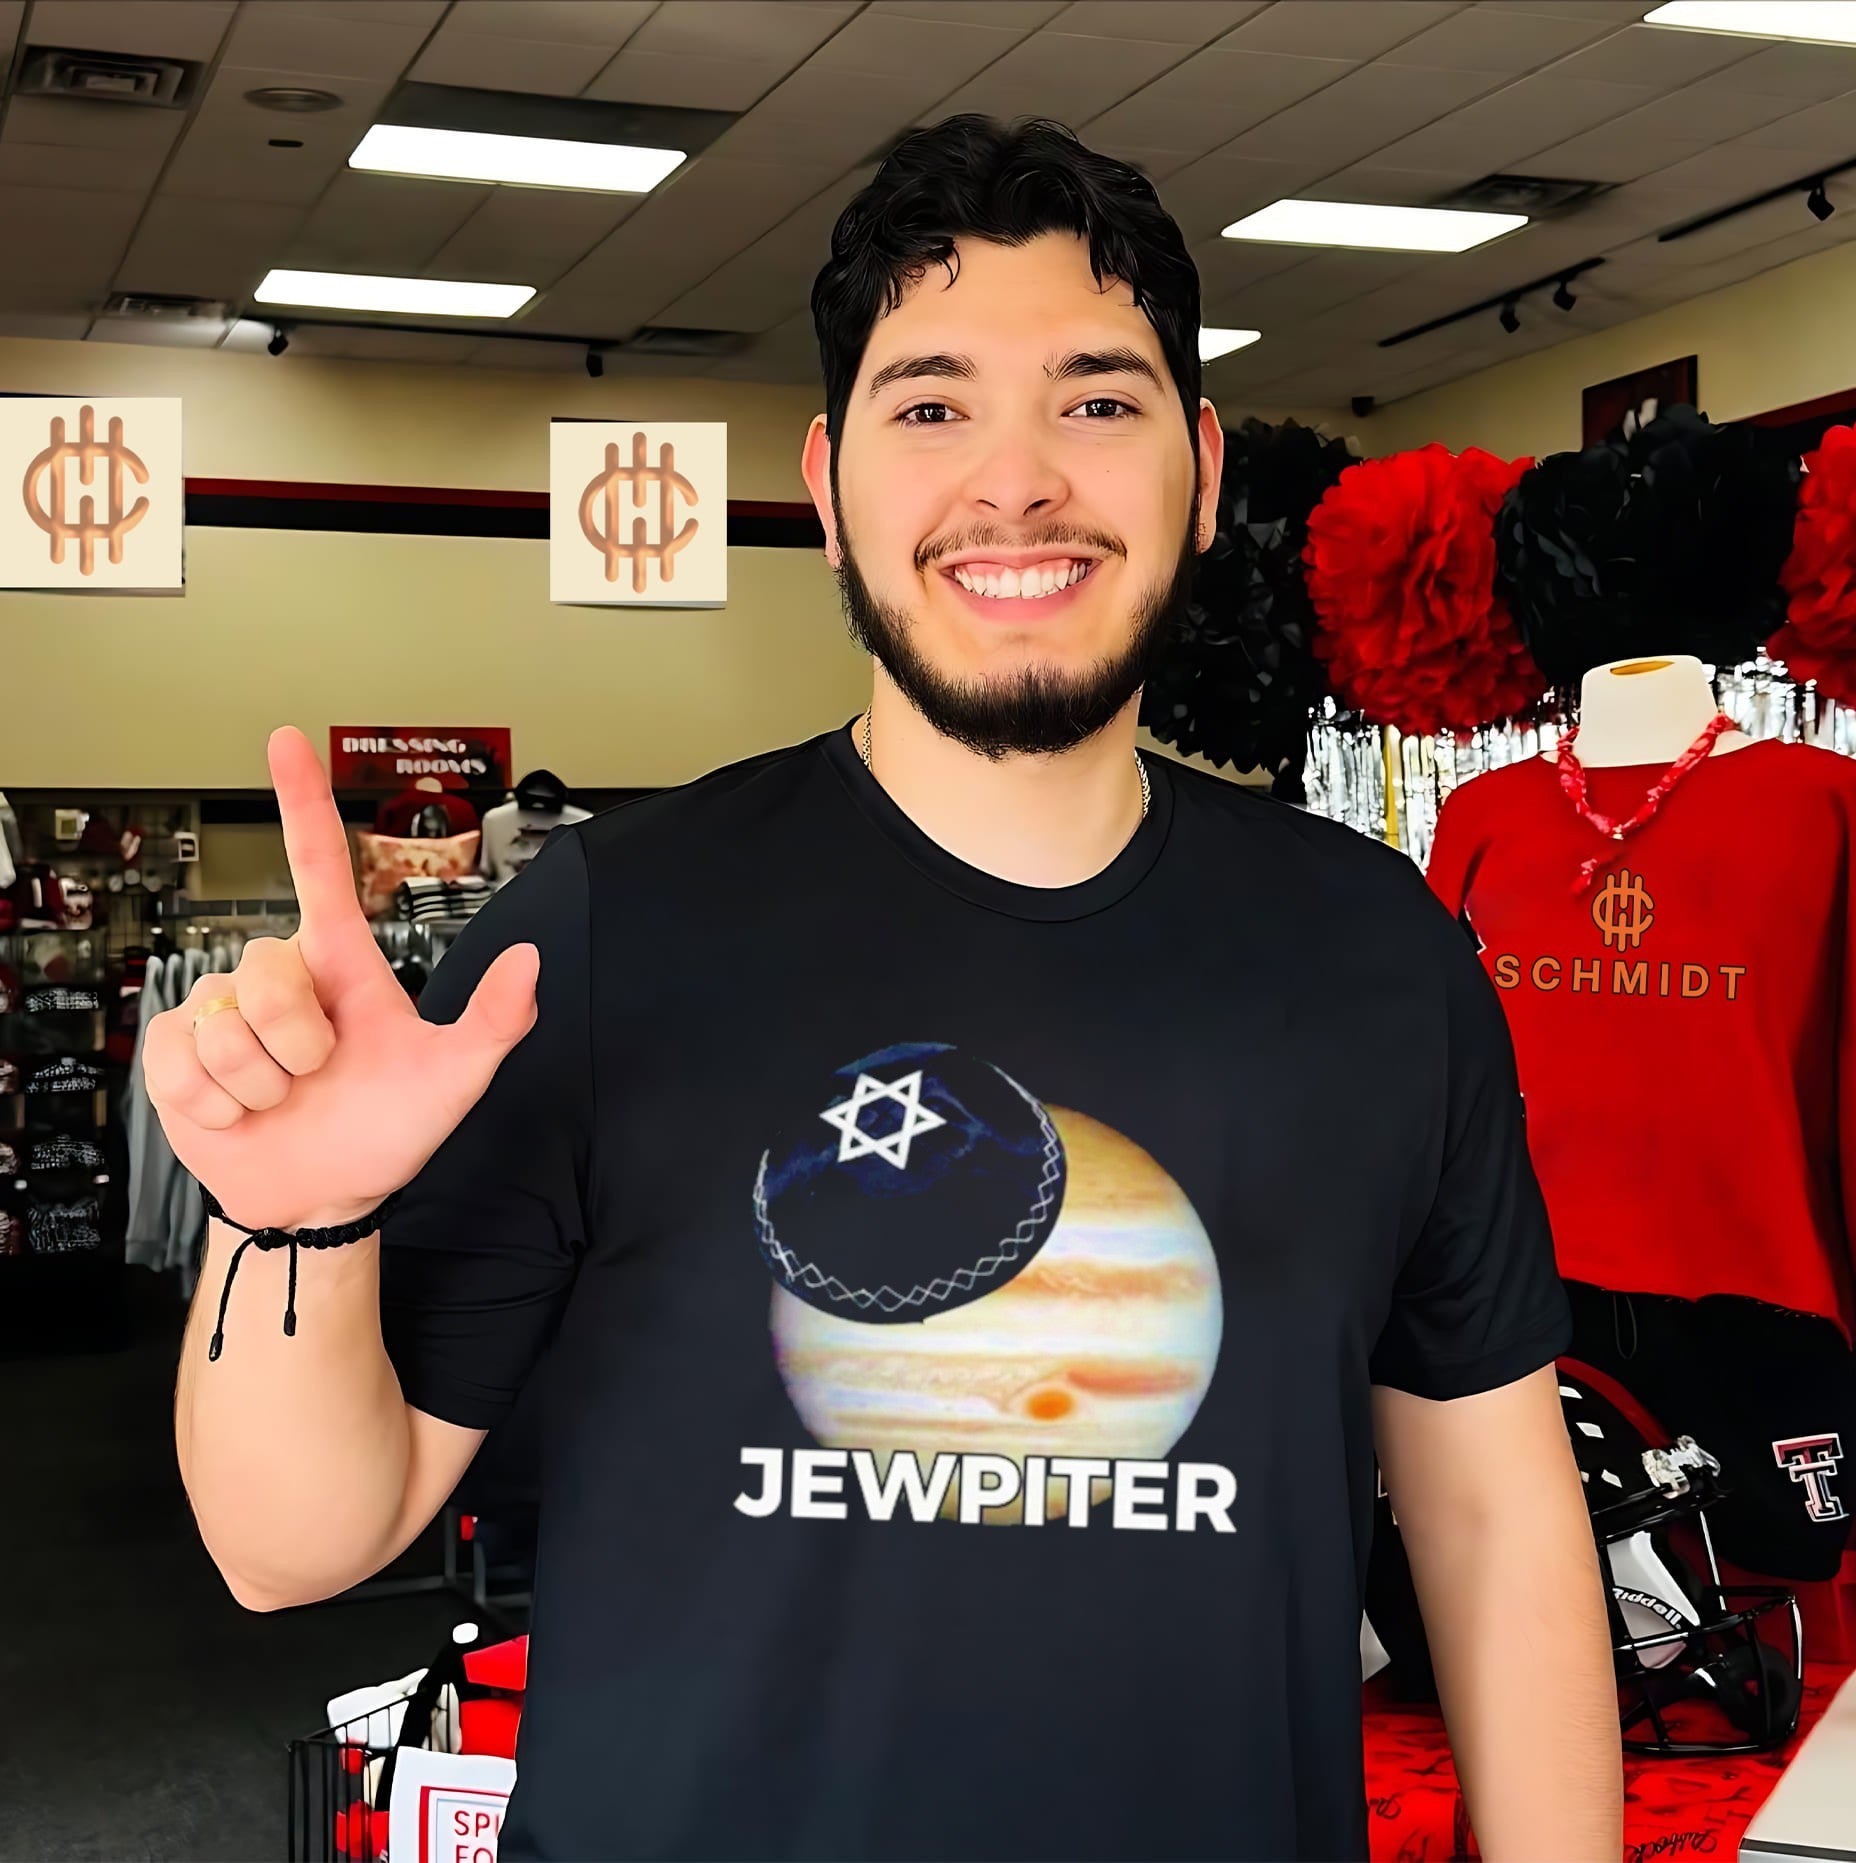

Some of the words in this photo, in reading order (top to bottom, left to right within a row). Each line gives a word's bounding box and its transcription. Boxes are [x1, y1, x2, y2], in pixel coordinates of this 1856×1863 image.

[342, 737, 467, 753] DRESSING
[396, 759, 487, 775] ROOMS
[1494, 954, 1746, 1000] SCHMIDT
[733, 1447, 1237, 1533] JEWPITER
